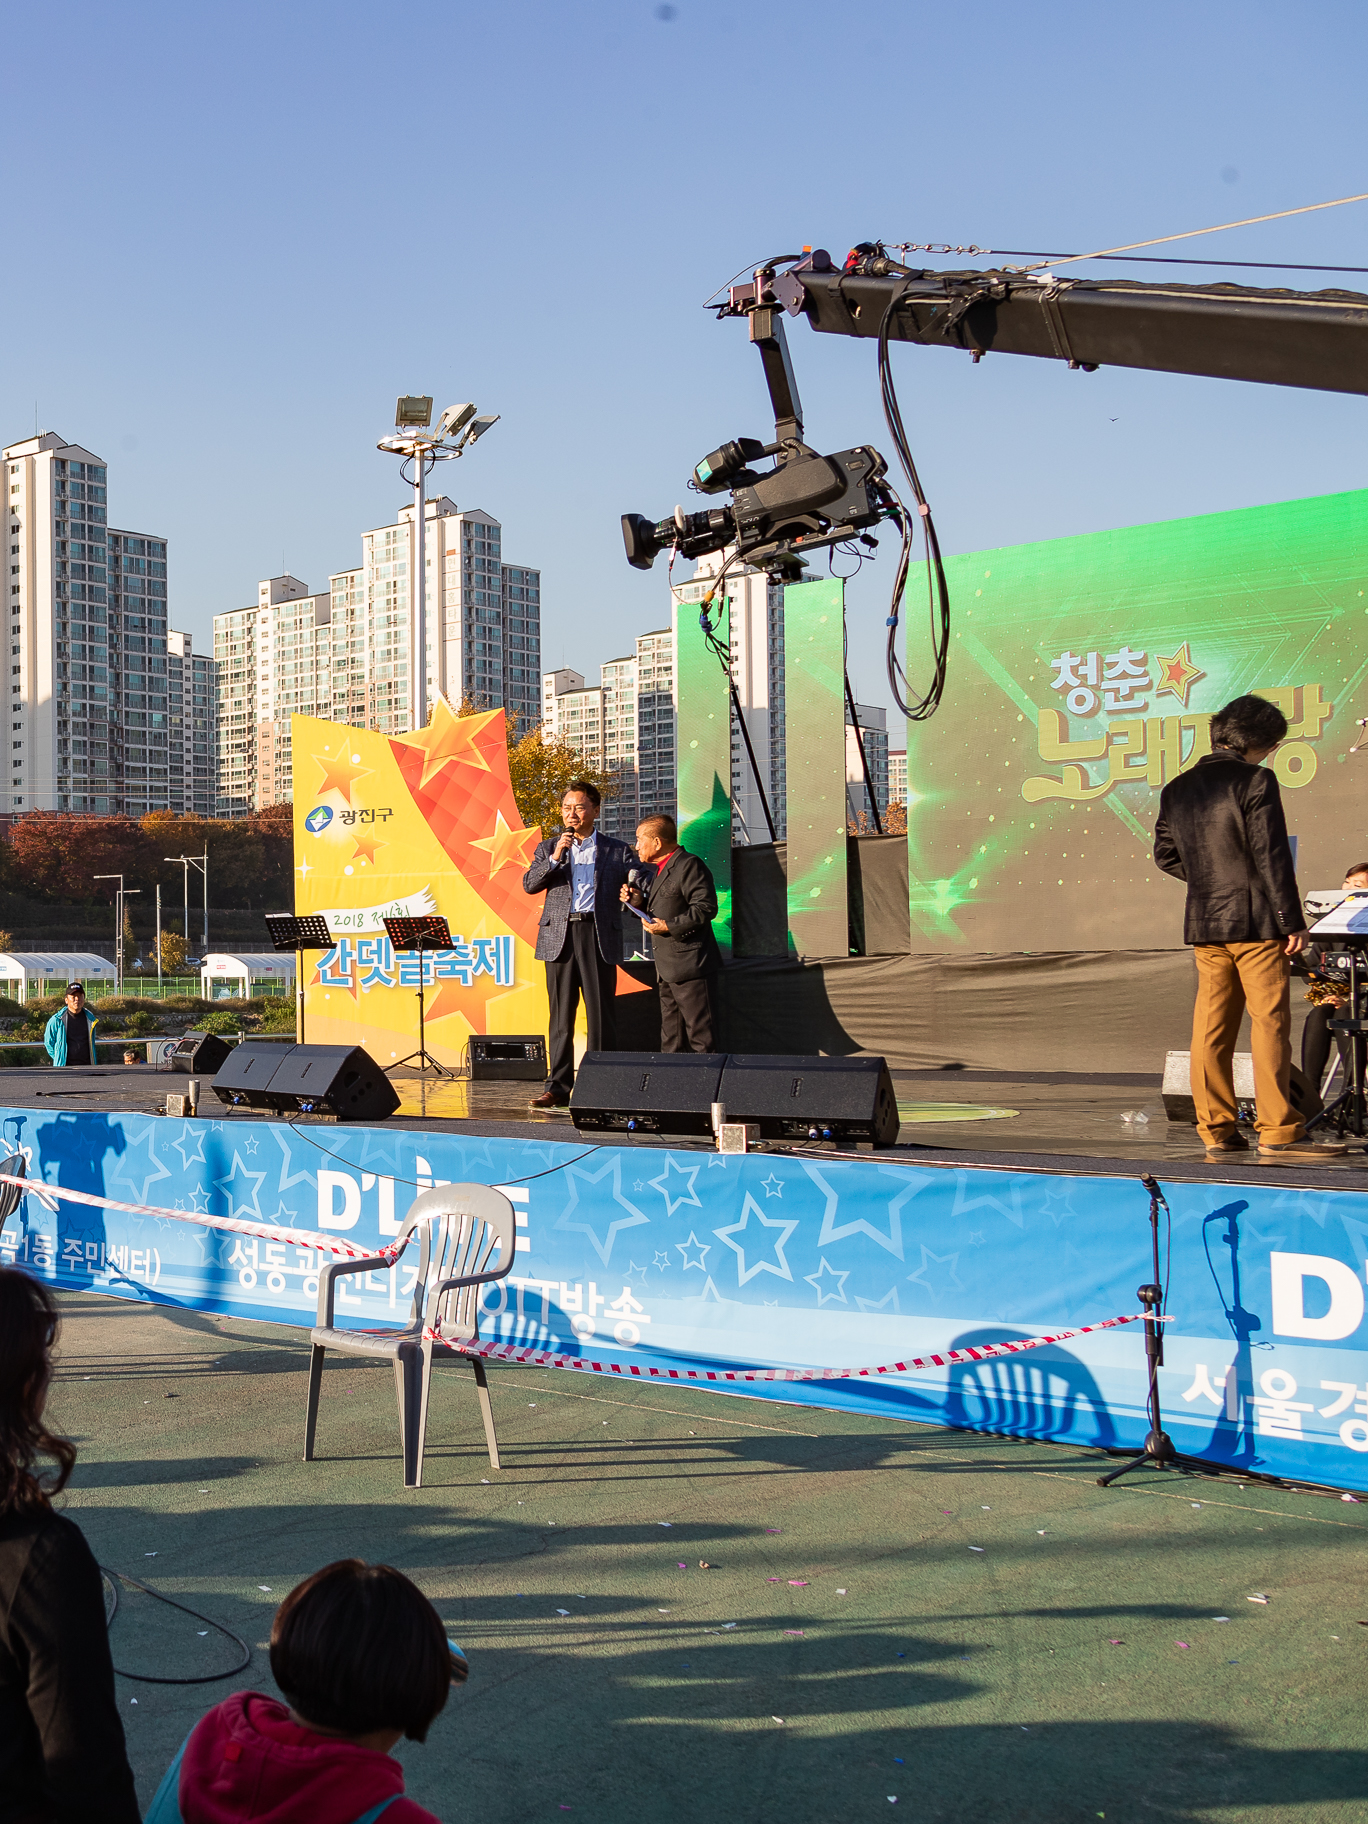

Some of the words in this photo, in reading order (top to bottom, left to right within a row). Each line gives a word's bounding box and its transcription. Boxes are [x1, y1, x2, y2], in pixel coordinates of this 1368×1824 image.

[1050, 645, 1151, 715] 청춘
[1021, 682, 1333, 803] 노래랑
[338, 807, 394, 826] 광진구
[333, 912, 365, 928] 2018
